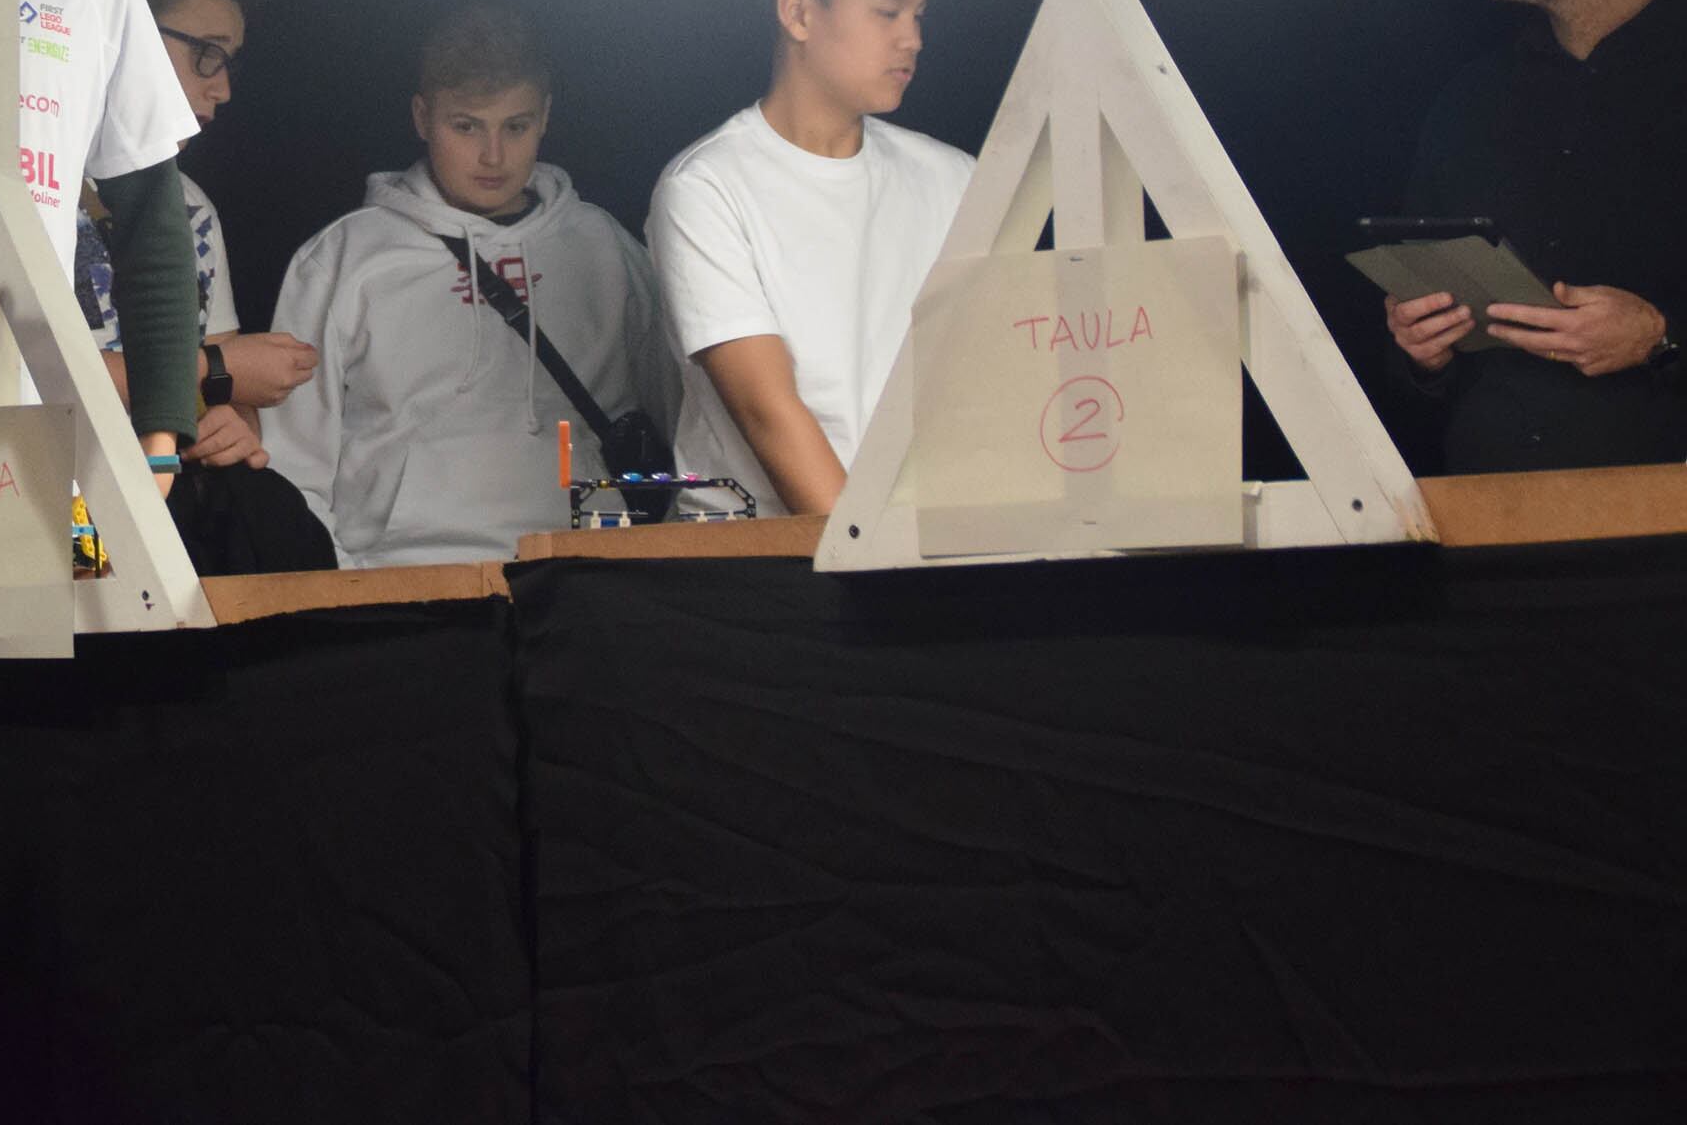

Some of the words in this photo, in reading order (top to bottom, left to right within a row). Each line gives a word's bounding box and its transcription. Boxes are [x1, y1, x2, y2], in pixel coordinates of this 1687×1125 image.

[40, 3, 64, 15] FIRST
[40, 12, 62, 24] LEGO
[40, 21, 71, 35] LEAGUE
[1013, 306, 1153, 351] TAULA
[1058, 398, 1107, 443] 2
